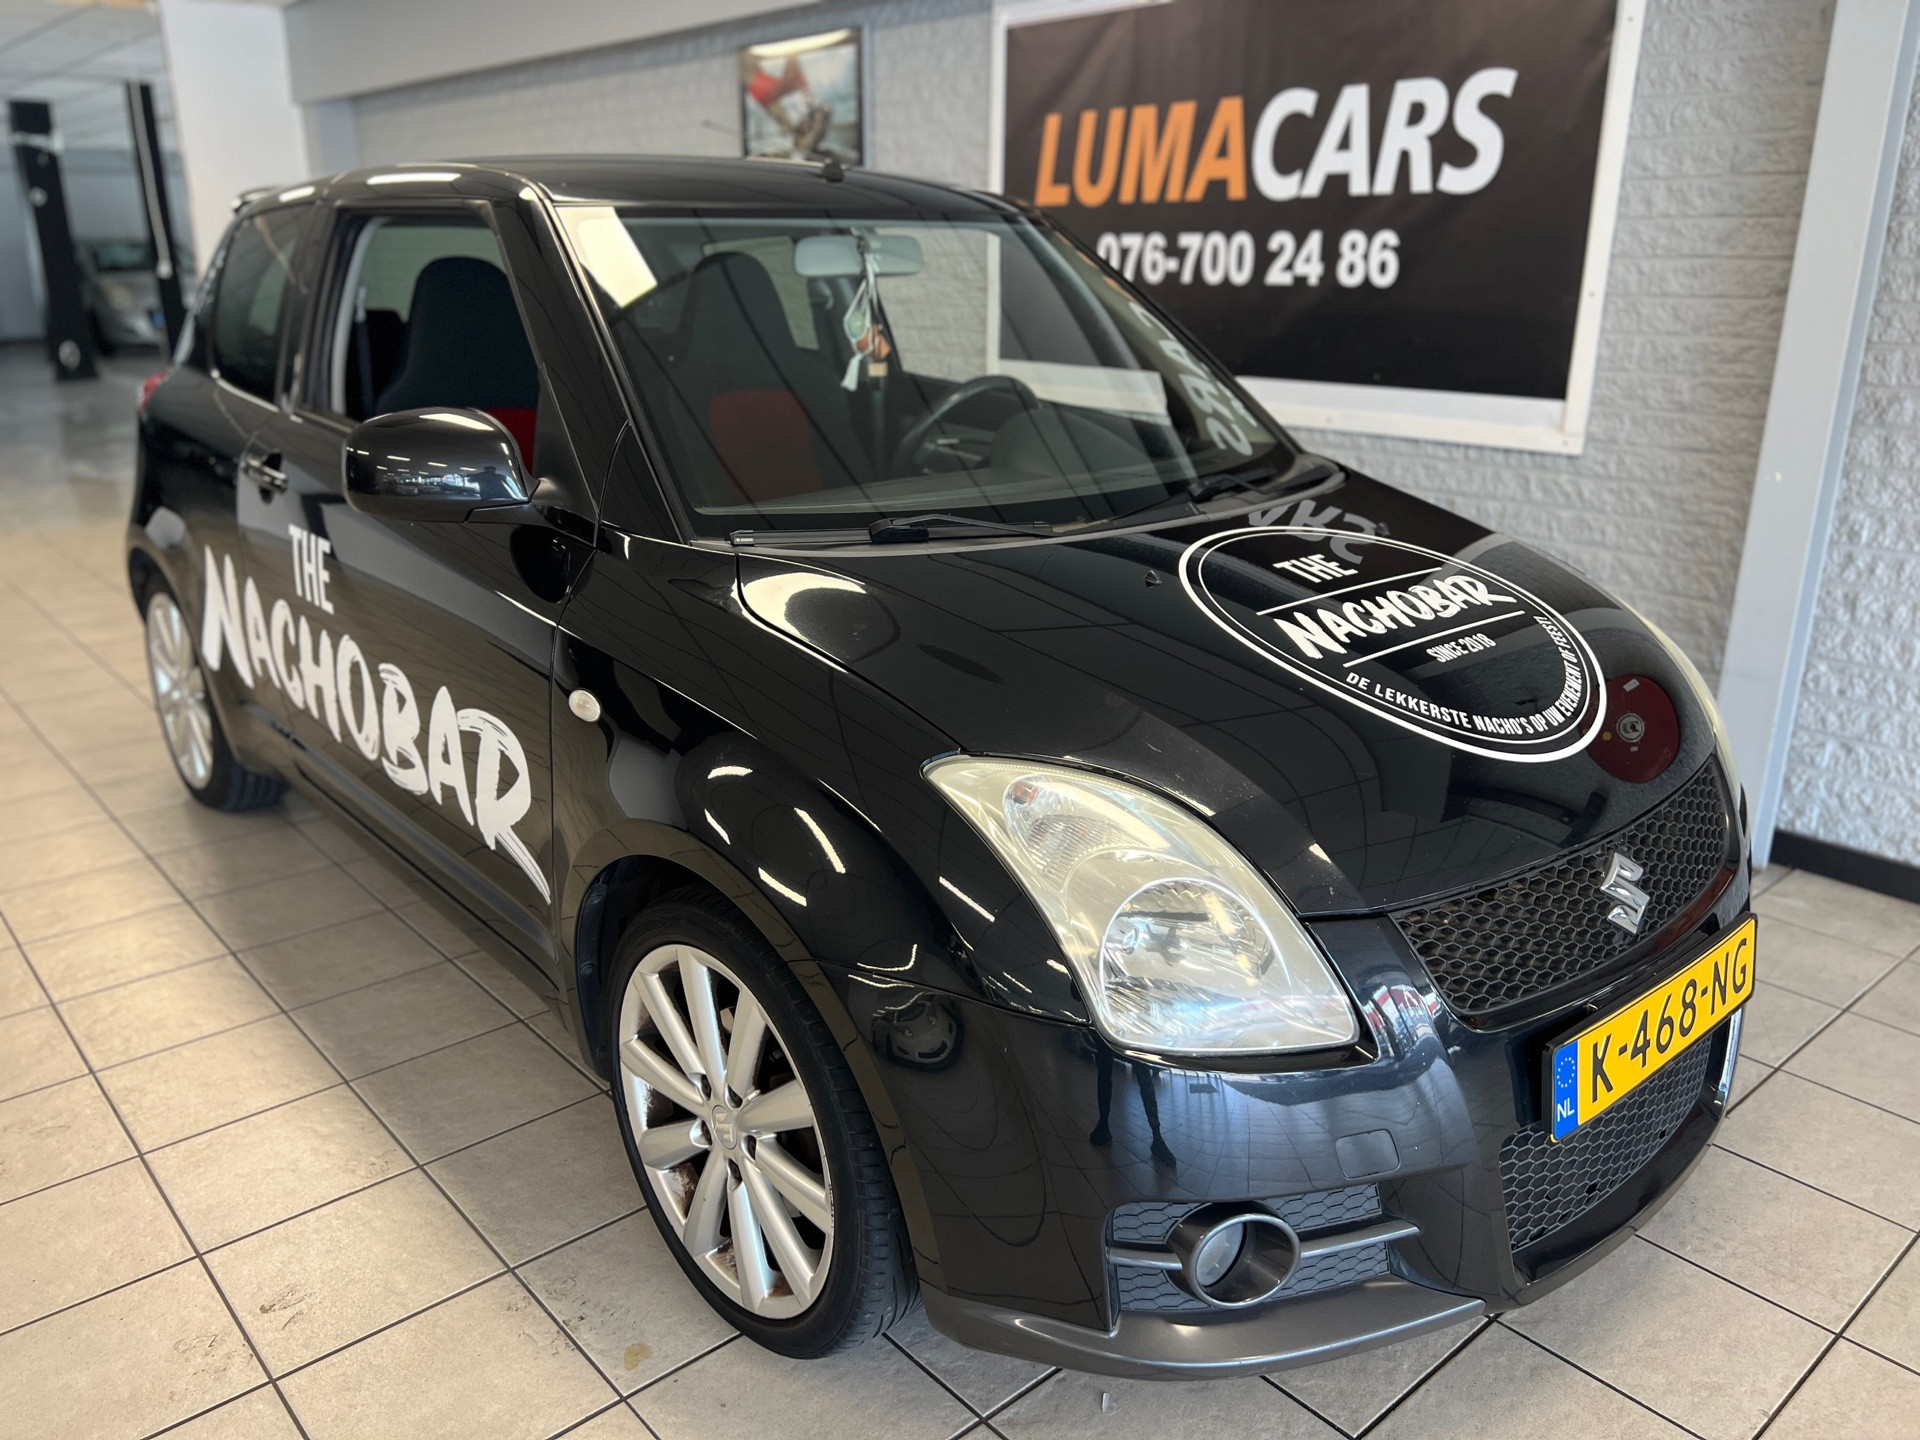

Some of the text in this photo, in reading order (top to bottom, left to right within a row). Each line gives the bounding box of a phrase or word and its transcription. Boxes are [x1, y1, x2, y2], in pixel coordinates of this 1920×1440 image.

[1034, 67, 1519, 207] LUMACARS
[1096, 228, 1401, 288] 076-700 24 86
[288, 523, 335, 615] THE
[1273, 553, 1359, 583] THE
[1274, 575, 1517, 659] NACHOBAR
[1426, 632, 1497, 663] SINCE 2018
[1346, 615, 1582, 735] DE LEKKERSTE NACHO'S OP UW EVENEMENT OF FEEST!
[203, 545, 552, 905] NACHOBAR
[1592, 938, 1748, 1104] K-468-NG
[1556, 1097, 1576, 1123] NL
